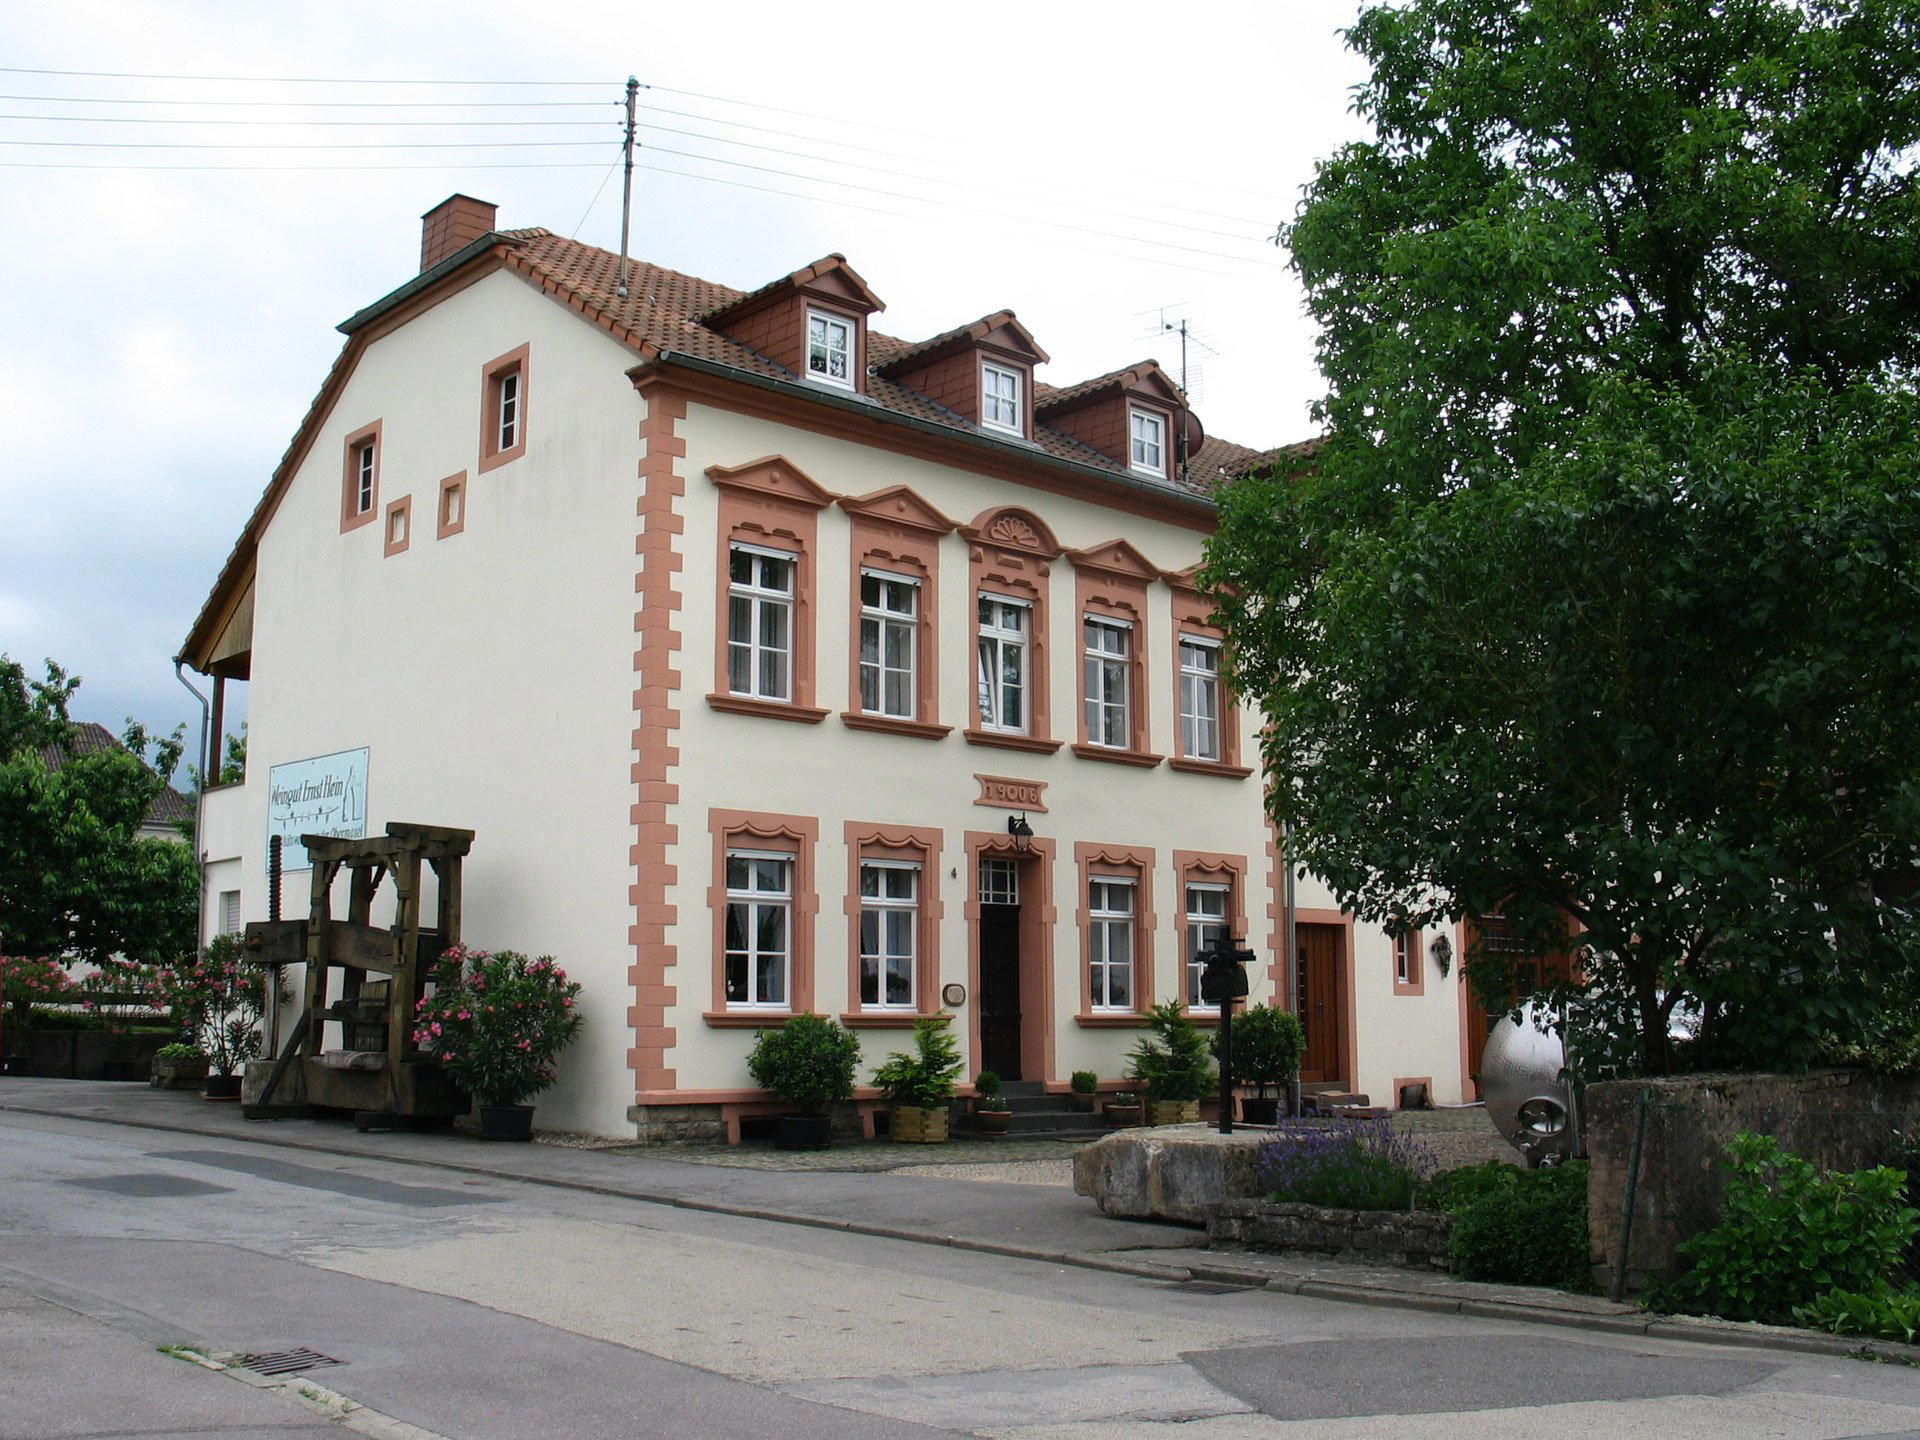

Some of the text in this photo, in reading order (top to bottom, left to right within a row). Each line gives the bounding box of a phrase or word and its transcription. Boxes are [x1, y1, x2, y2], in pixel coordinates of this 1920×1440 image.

[272, 775, 344, 809] Weingut Ernst Hein
